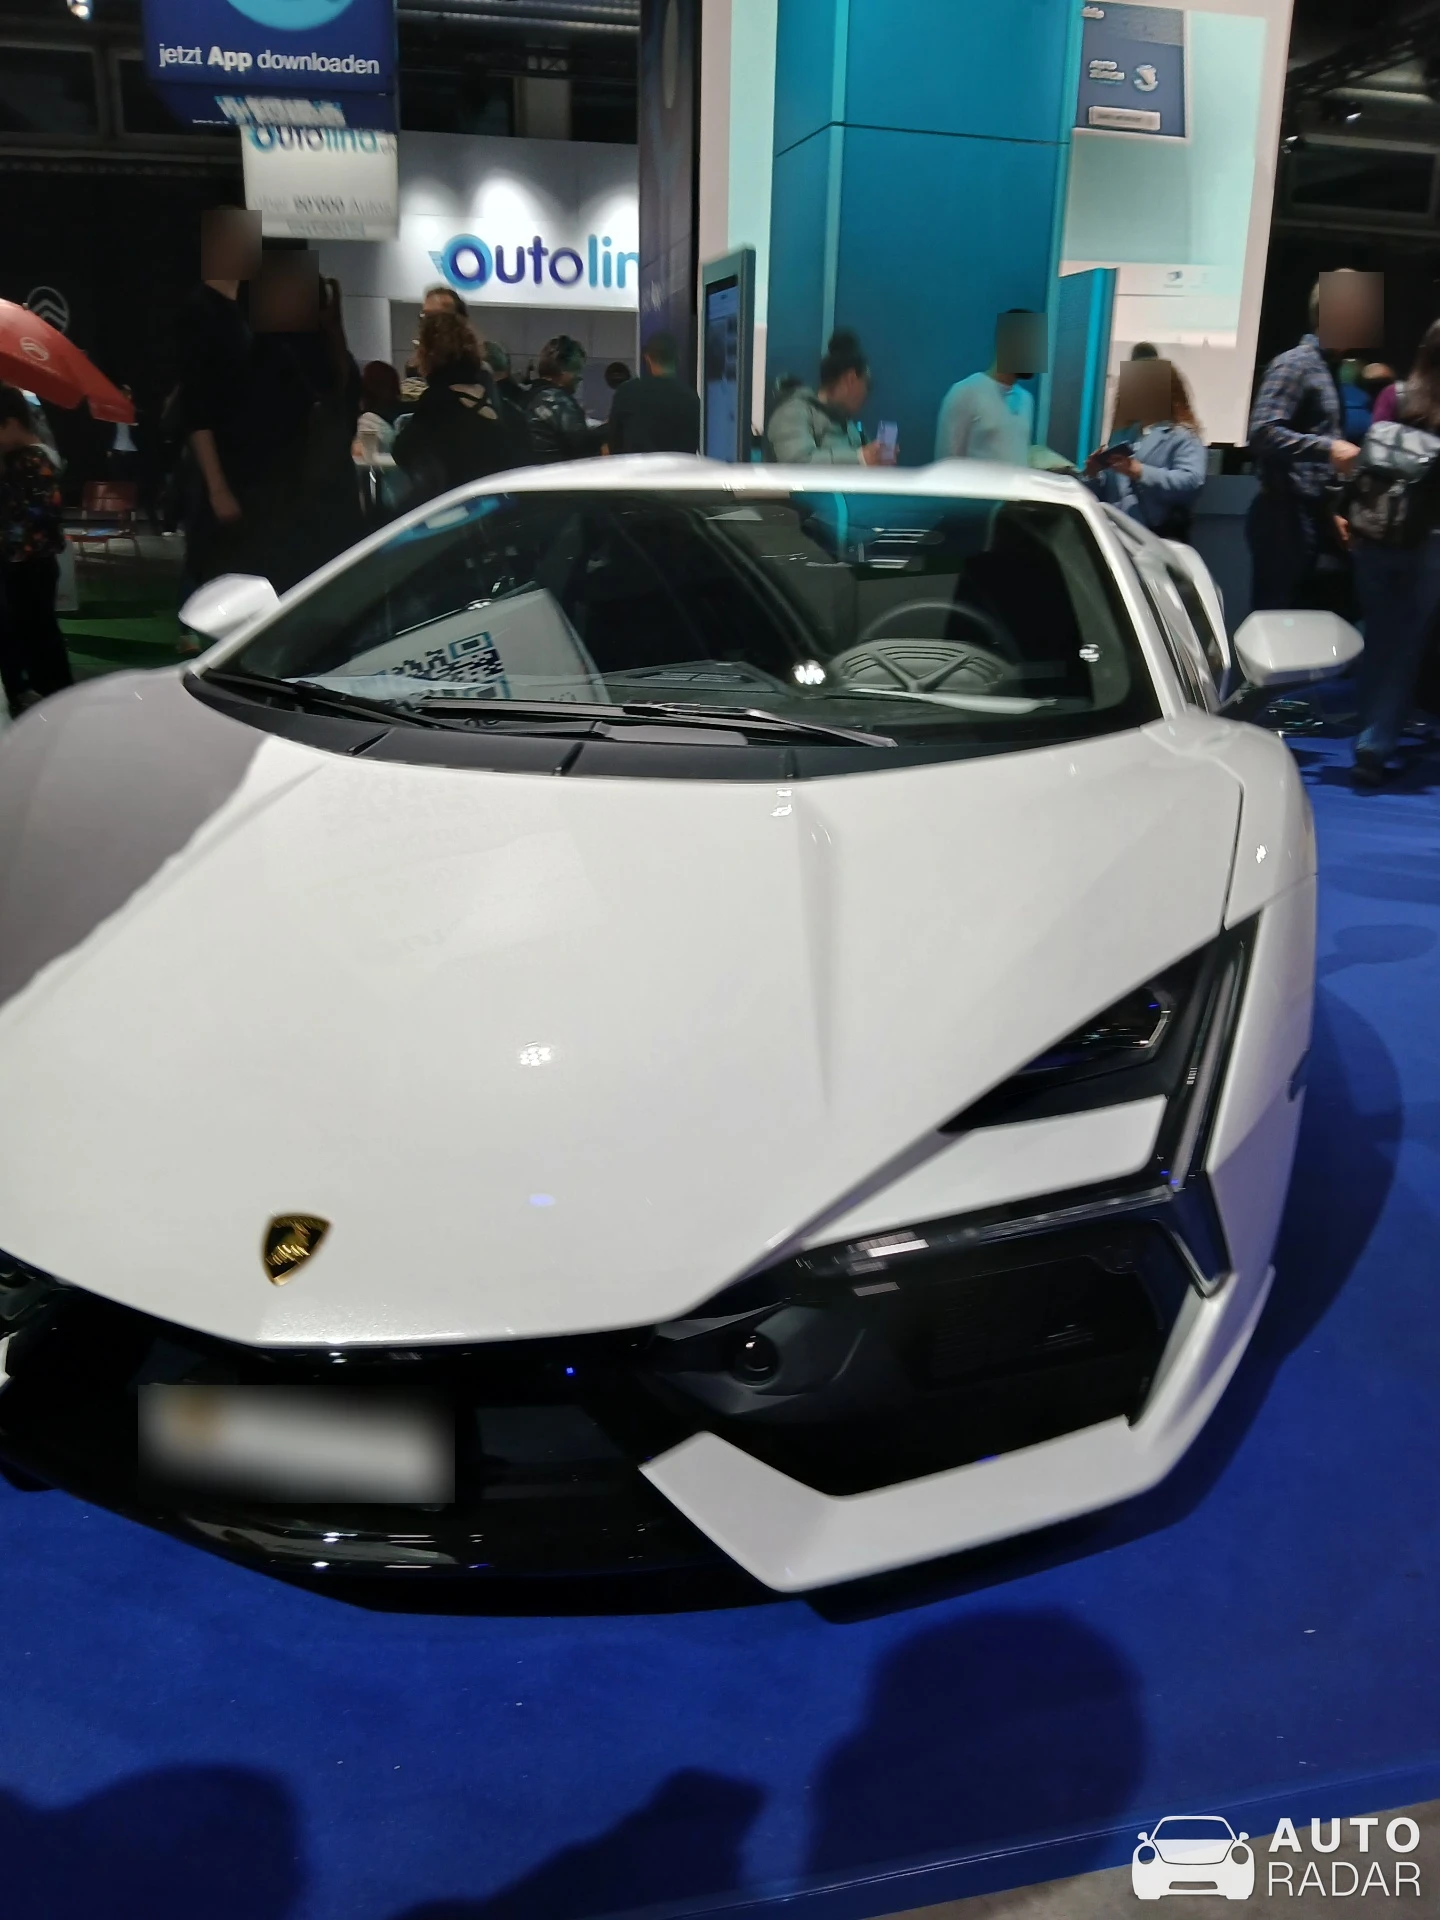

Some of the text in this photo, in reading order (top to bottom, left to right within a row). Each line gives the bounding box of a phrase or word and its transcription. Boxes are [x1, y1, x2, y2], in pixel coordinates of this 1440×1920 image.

[159, 43, 380, 75] jetzt App downloaden
